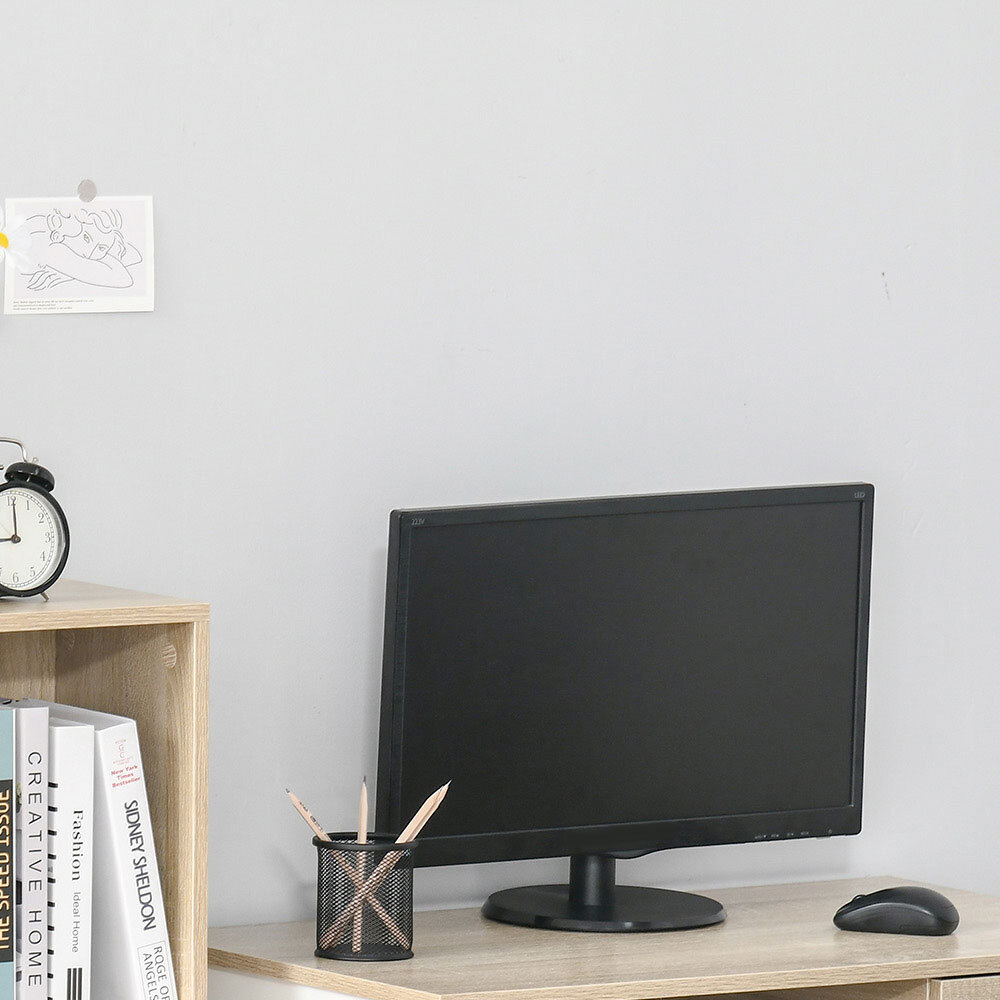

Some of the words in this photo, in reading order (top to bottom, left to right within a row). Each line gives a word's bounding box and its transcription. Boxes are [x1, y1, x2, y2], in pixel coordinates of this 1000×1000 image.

[26, 500, 30, 510] 1
[38, 513, 45, 524] 2
[45, 532, 51, 543] 3
[40, 551, 46, 561] 4
[12, 572, 19, 583] 6
[30, 566, 36, 577] 5
[28, 751, 42, 893] CREATIVE
[124, 800, 145, 854] SIDNEY
[71, 810, 84, 881] Fashion
[72, 891, 82, 917] Ideal
[133, 855, 157, 931] SHELDON
[28, 909, 42, 987] HOME
[71, 921, 81, 953] Home
